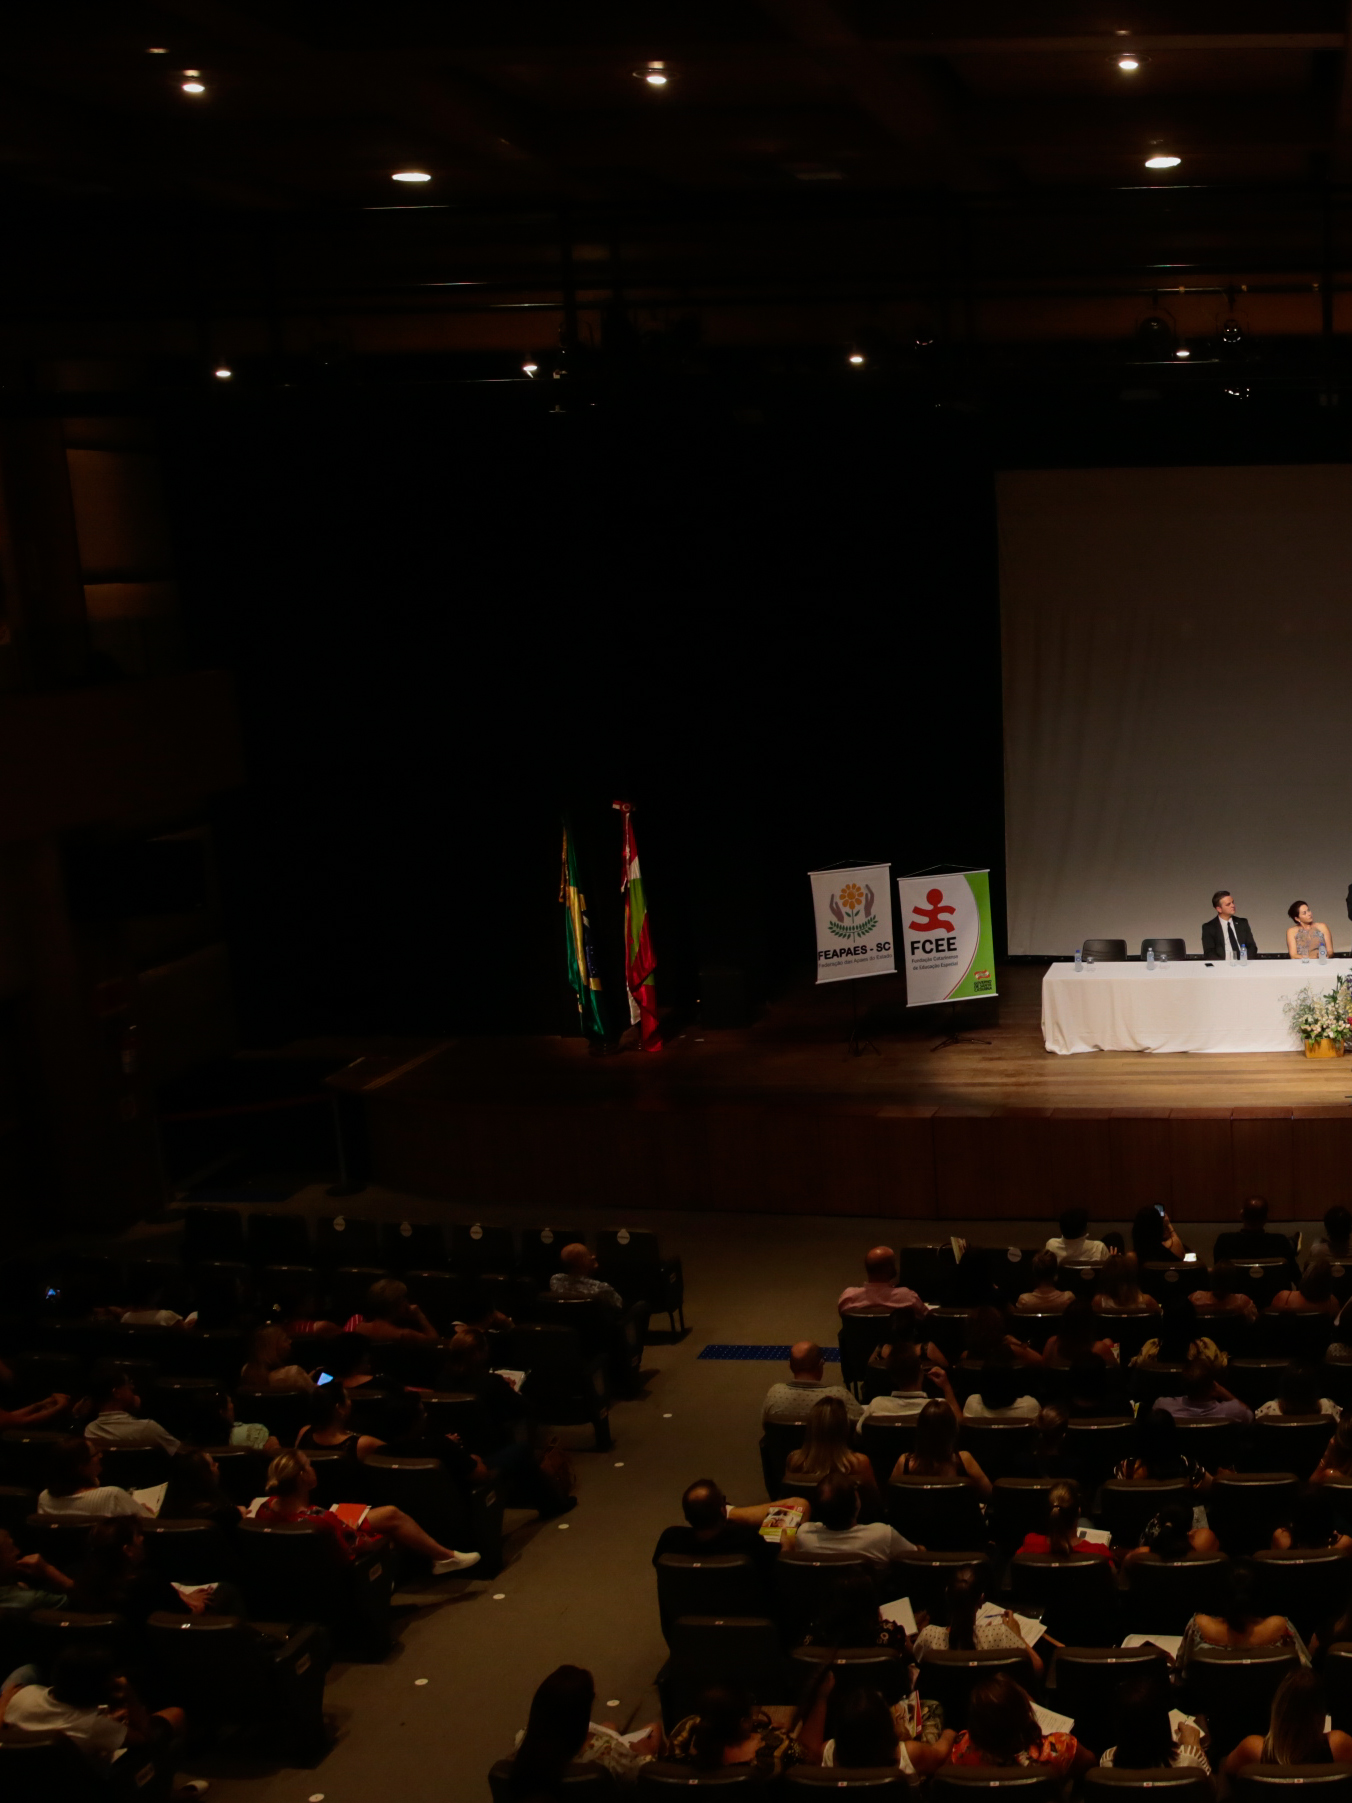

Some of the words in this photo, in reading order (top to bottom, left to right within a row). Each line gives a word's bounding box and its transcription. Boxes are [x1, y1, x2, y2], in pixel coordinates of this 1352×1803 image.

[818, 945, 867, 960] FEAPAES
[876, 941, 891, 952] SC
[910, 936, 957, 956] FCEE
